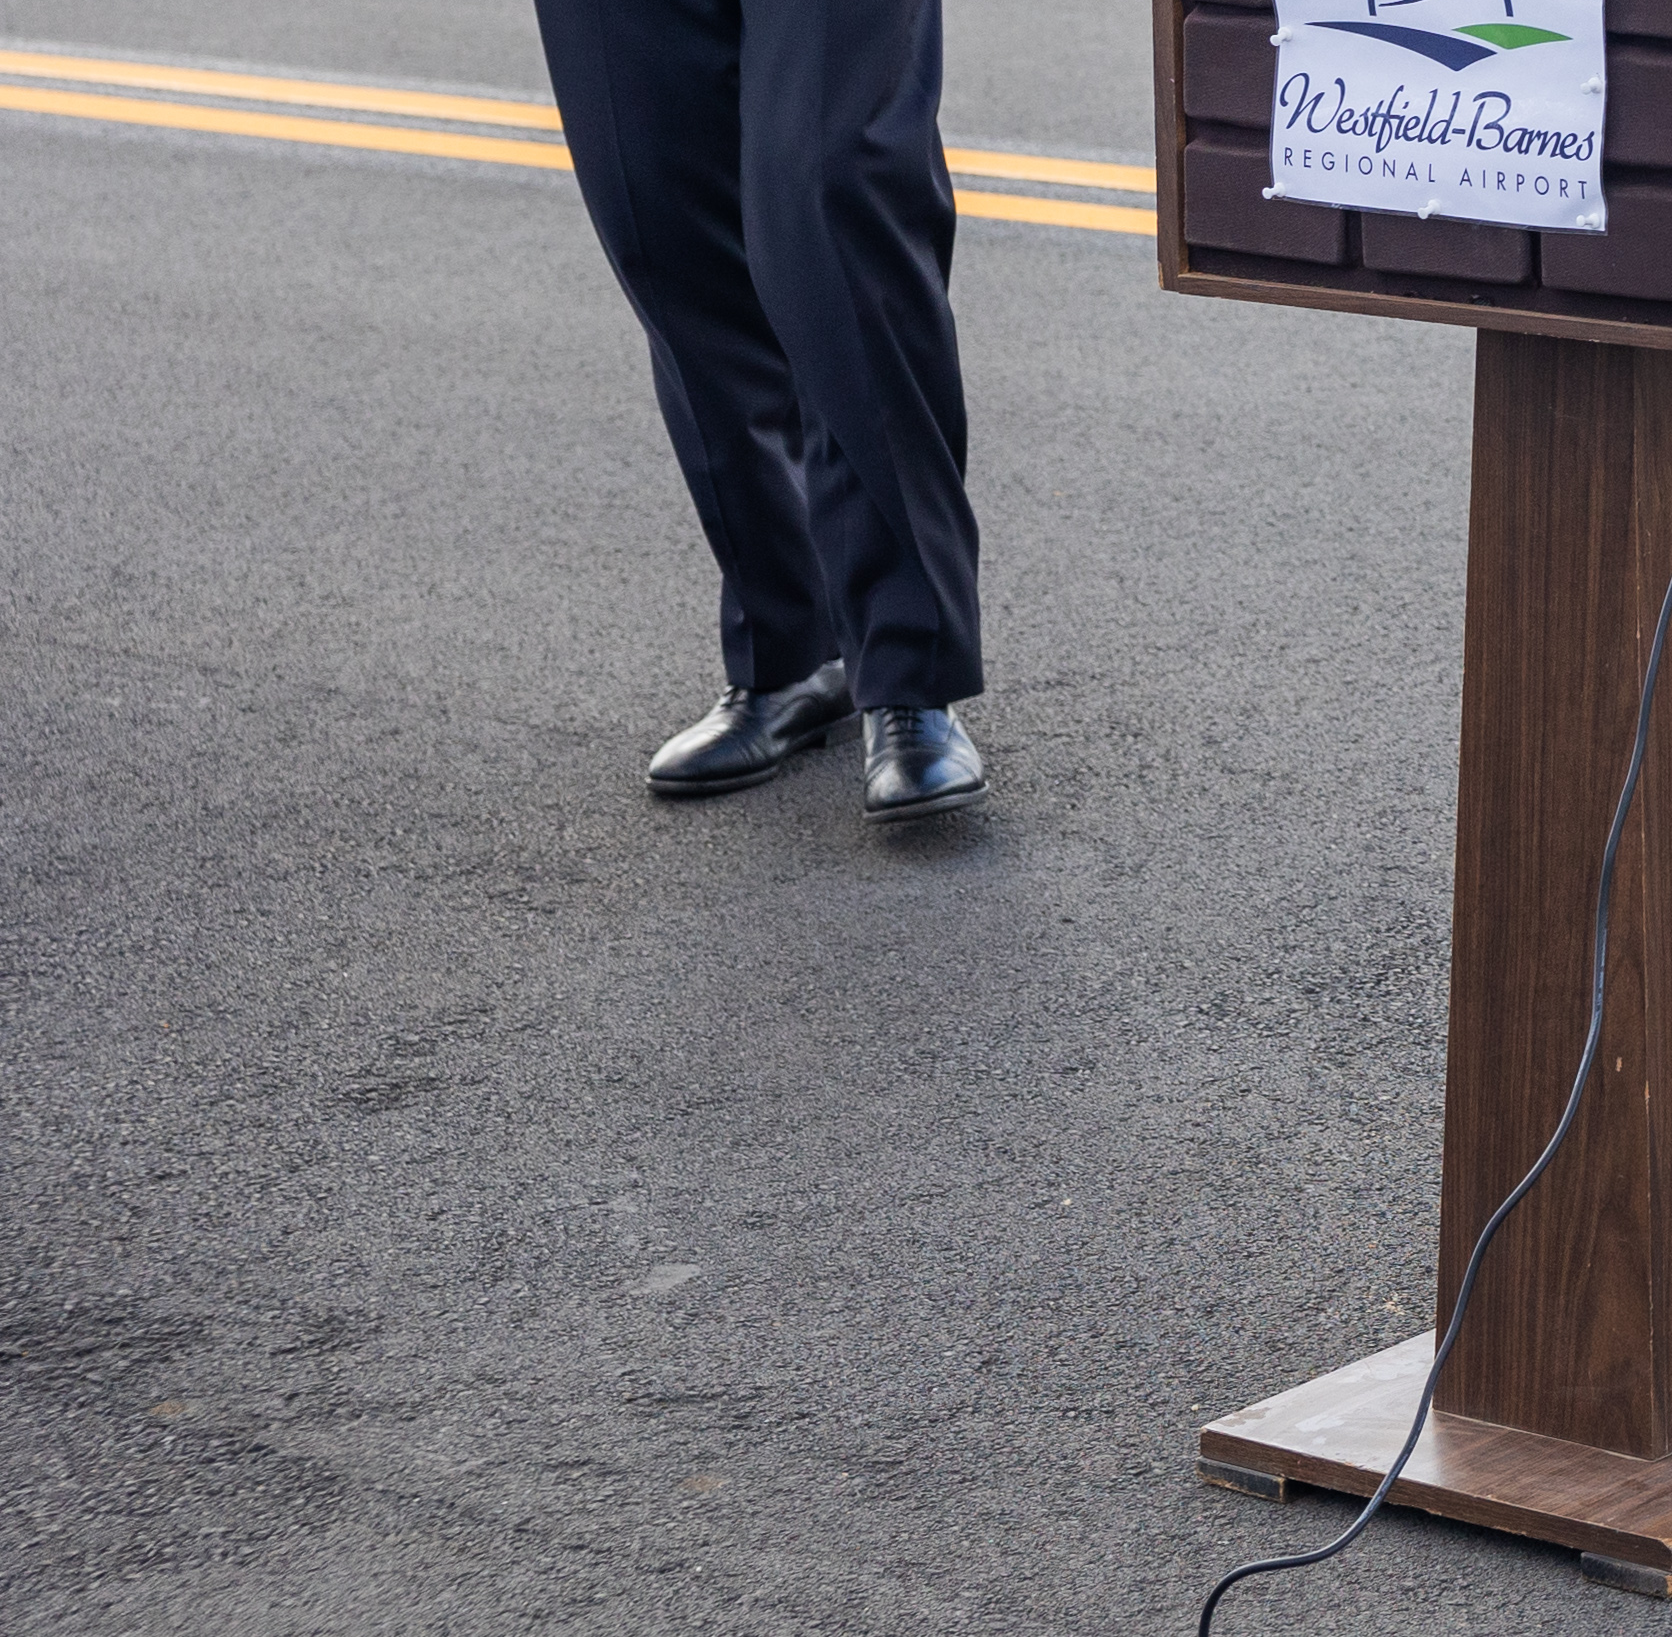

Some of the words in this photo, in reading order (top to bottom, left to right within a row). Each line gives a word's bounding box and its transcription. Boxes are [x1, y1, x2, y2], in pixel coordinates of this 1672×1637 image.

[1279, 72, 1595, 161] Westfield-Barnes
[1284, 147, 1436, 183] REGIONAL
[1459, 167, 1588, 200] AIRPORT
